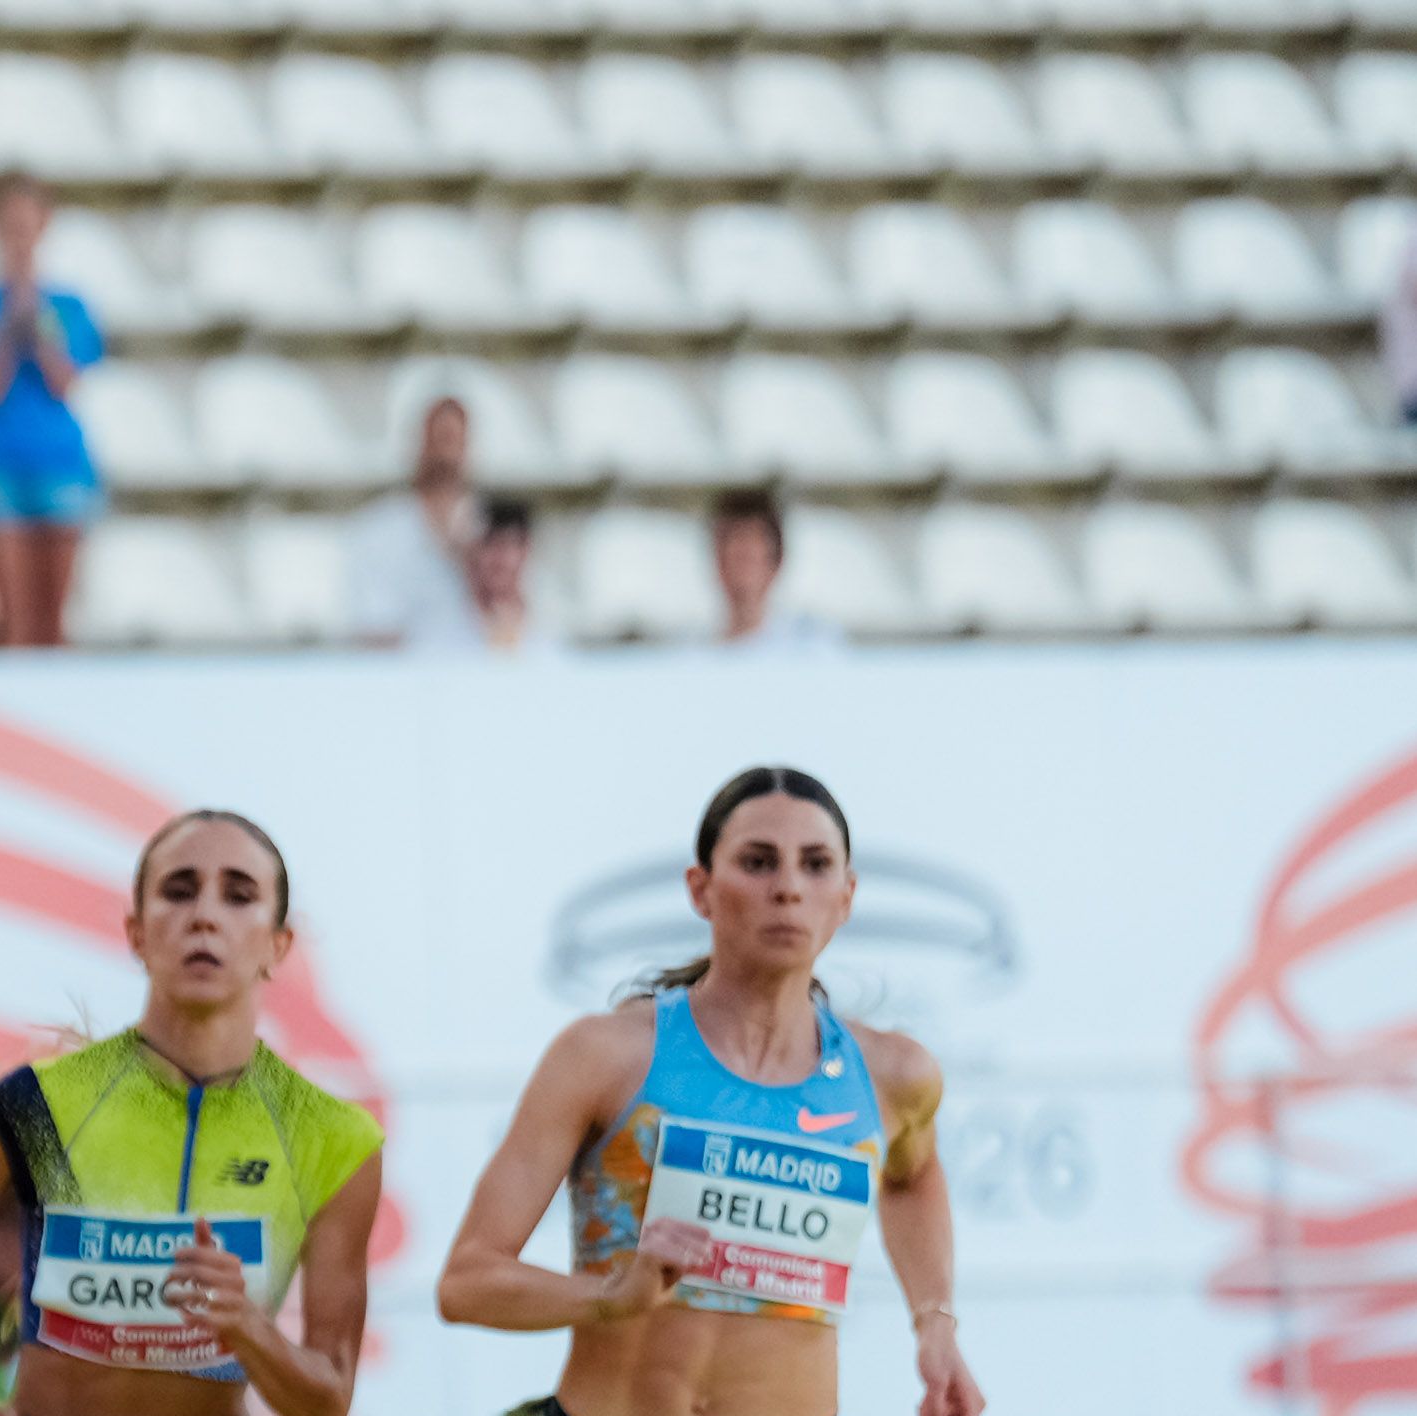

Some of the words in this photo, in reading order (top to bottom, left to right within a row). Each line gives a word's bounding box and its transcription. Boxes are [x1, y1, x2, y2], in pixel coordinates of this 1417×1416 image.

[734, 1147, 842, 1195] MADRID
[945, 1103, 1098, 1220] 26
[698, 1188, 829, 1240] BELLO
[110, 1232, 224, 1259] MAD
[724, 1245, 824, 1279] Comunidad
[720, 1265, 748, 1289] de
[753, 1269, 824, 1301] Madrid
[112, 1326, 209, 1344] Comunid
[145, 1341, 218, 1363] Madrid
